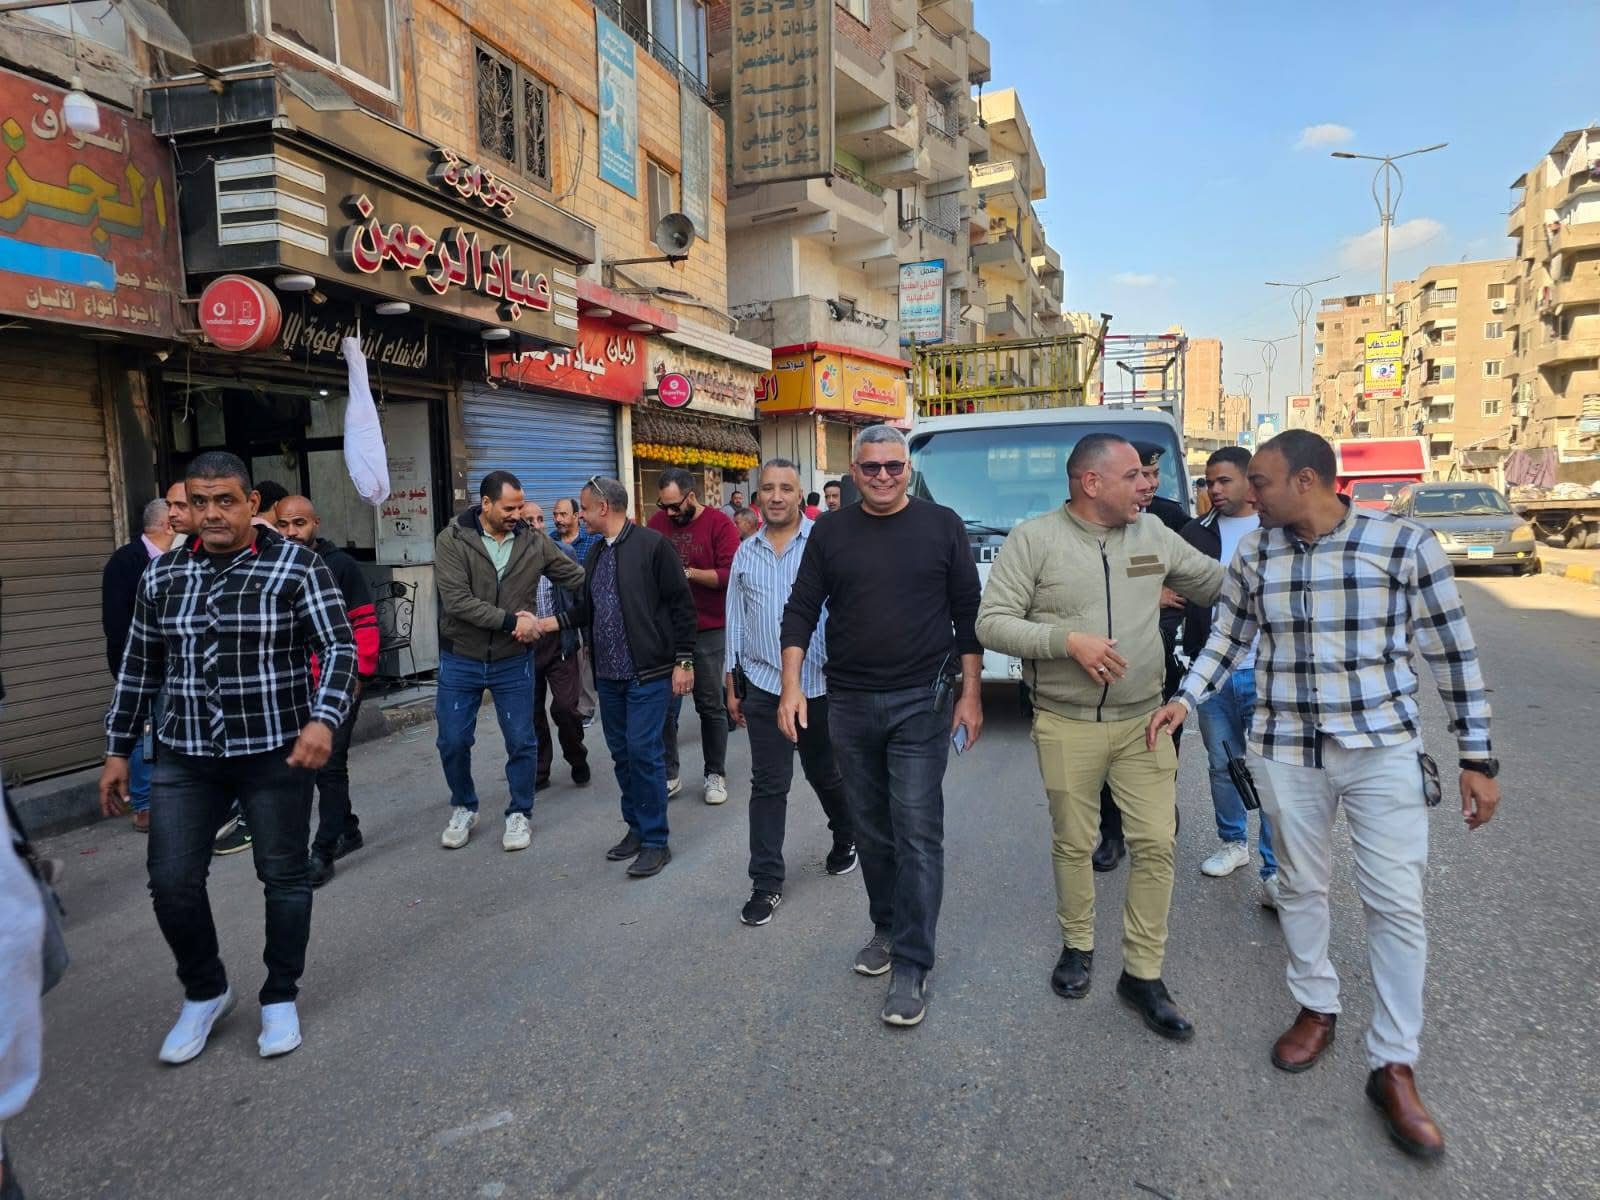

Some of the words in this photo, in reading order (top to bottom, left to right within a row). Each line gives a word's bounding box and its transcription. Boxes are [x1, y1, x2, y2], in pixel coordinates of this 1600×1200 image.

[737, 22, 775, 46] خارجية
[781, 19, 818, 37] عيادات
[737, 47, 785, 75] متخصص
[788, 46, 819, 66] معمل
[787, 121, 819, 146] علاج
[441, 148, 517, 218] جزارة
[352, 194, 482, 295] الرحمن
[486, 244, 552, 321] عباد
